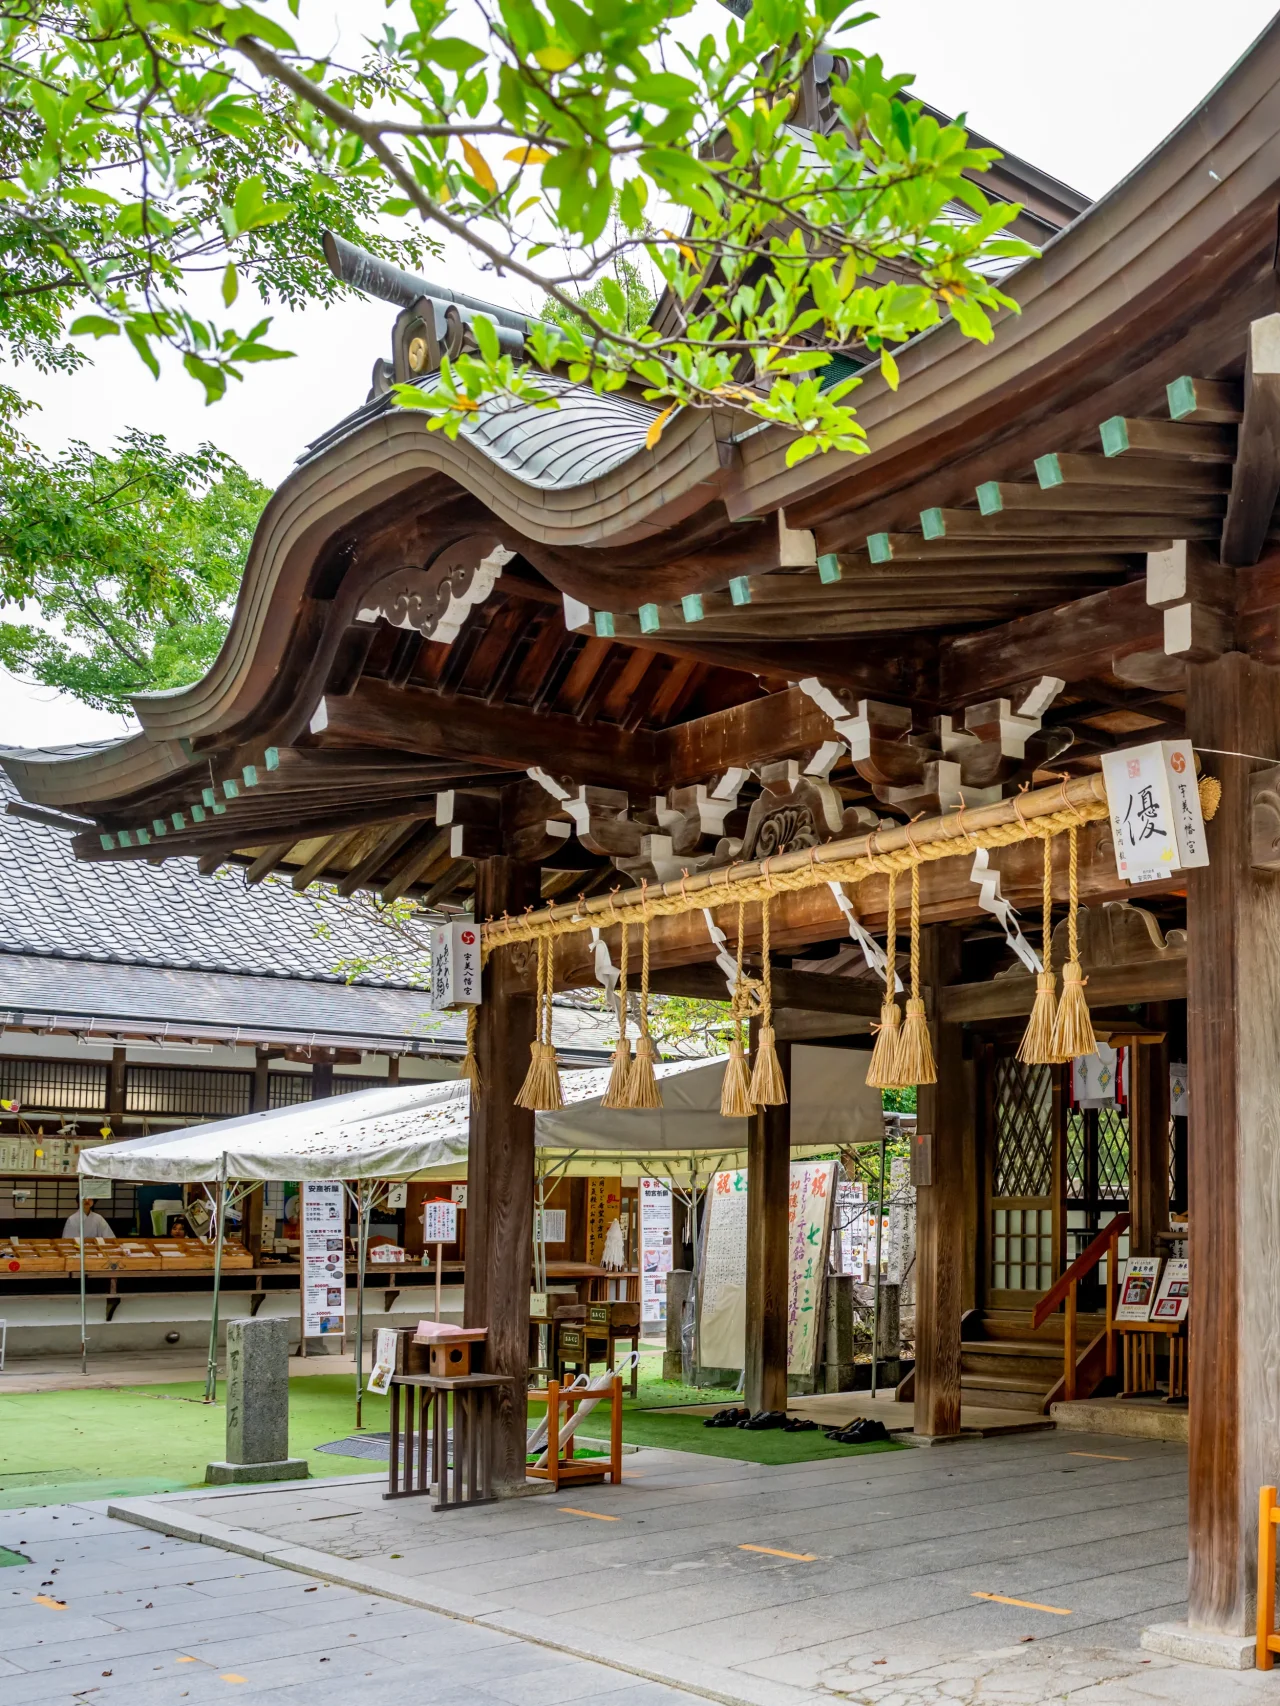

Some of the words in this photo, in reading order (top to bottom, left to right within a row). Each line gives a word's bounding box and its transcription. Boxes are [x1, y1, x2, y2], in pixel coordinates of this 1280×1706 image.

[1123, 784, 1168, 847] 優
[1178, 783, 1197, 855] 宇美八幡宮
[463, 952, 474, 996] 宇美八幡宮
[308, 1185, 340, 1193] 安産祈願
[716, 1172, 731, 1195] 祝
[733, 1172, 749, 1193] 七
[811, 1168, 828, 1199] 祝
[394, 1193, 402, 1203] 3
[457, 1194, 464, 1203] 2
